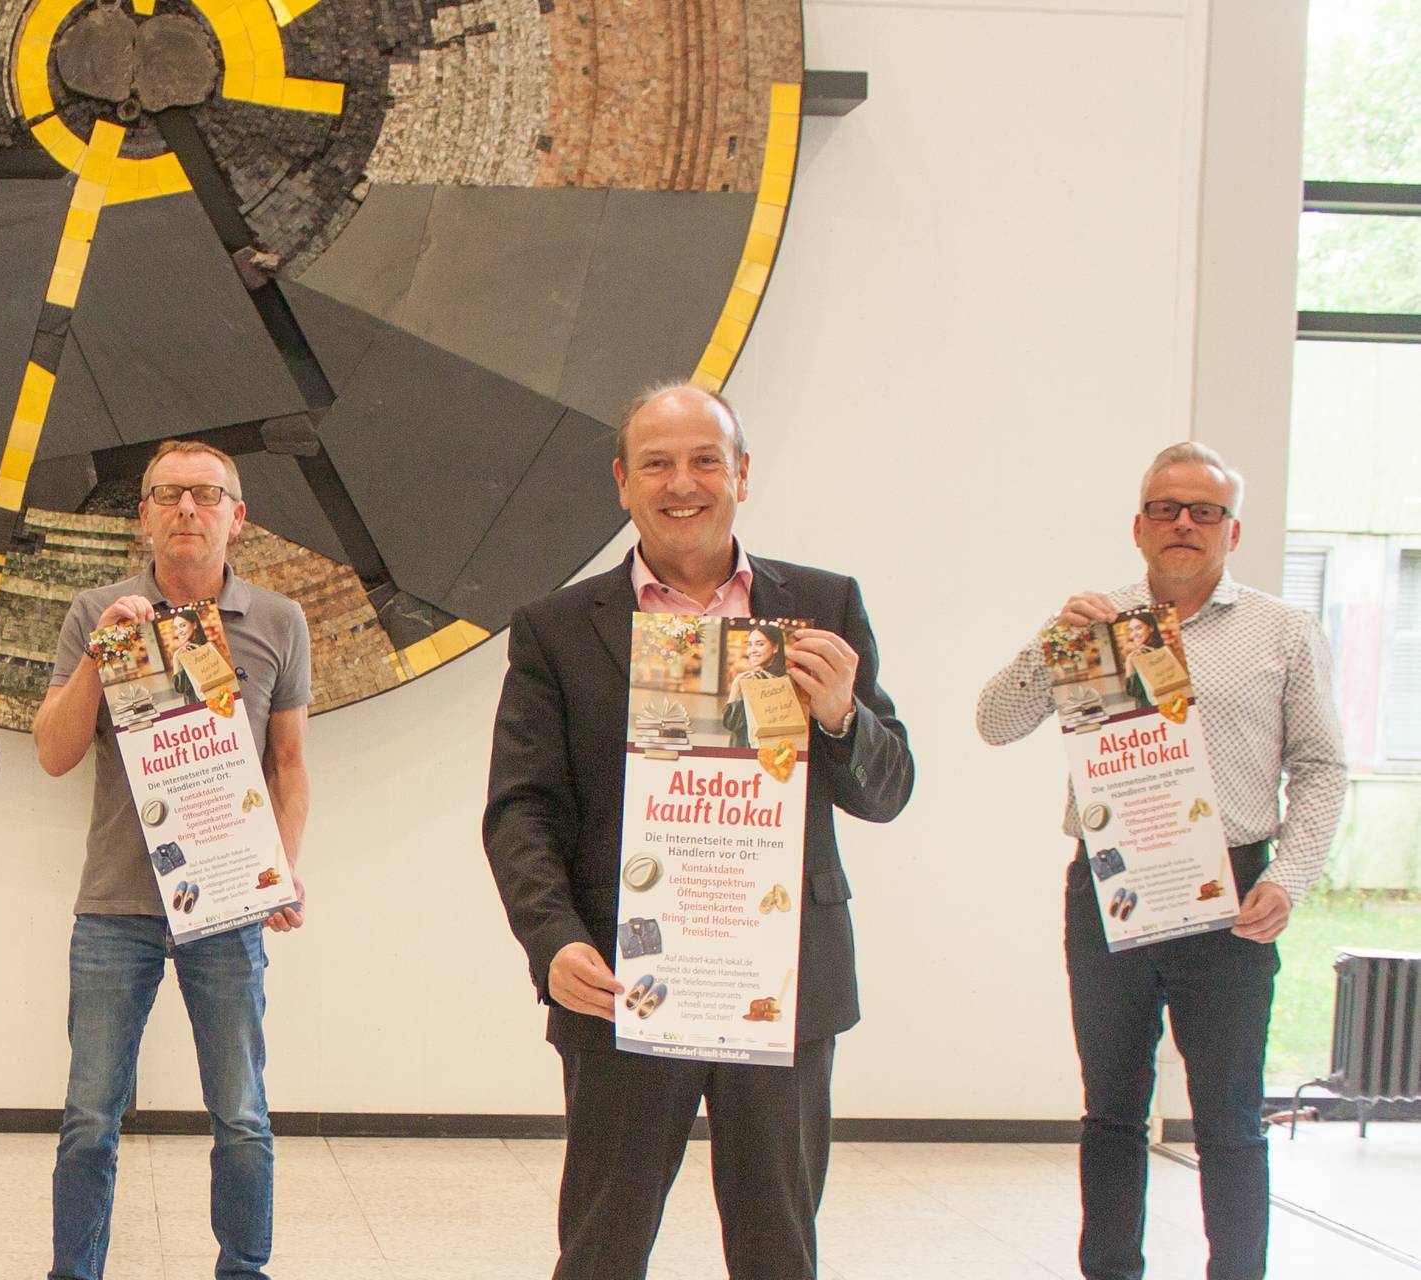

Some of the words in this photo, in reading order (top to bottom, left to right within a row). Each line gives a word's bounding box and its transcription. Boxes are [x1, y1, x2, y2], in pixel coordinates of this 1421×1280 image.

[153, 716, 216, 752] Alsdorf
[1099, 721, 1167, 755] Alsdorf
[141, 746, 190, 775] kauft
[191, 731, 239, 761] lokal
[1086, 750, 1136, 779] kauft
[1139, 737, 1189, 767] lokal
[147, 781, 160, 790] Die
[161, 768, 209, 786] Internetseite
[211, 763, 224, 772] mit
[225, 758, 245, 768] Ihren
[166, 780, 200, 794] Händlern
[201, 776, 214, 784] vor
[668, 769, 762, 799] Alsdorf
[645, 794, 712, 824] kauft
[717, 798, 782, 827] lokal
[644, 832, 662, 842] Die
[665, 833, 732, 846] Internetseite
[735, 837, 753, 847] mit
[756, 838, 783, 848] Ihren
[668, 846, 715, 858] Händlern
[718, 851, 735, 859] vor
[681, 862, 743, 874] Kontaktdaten
[668, 874, 755, 888] Leistungsspektrum
[676, 887, 746, 901] Öffnungszeiten
[678, 900, 743, 913] Speisenkarten
[661, 912, 689, 924] Bring-
[691, 914, 709, 923] und
[712, 915, 759, 927] Holservice
